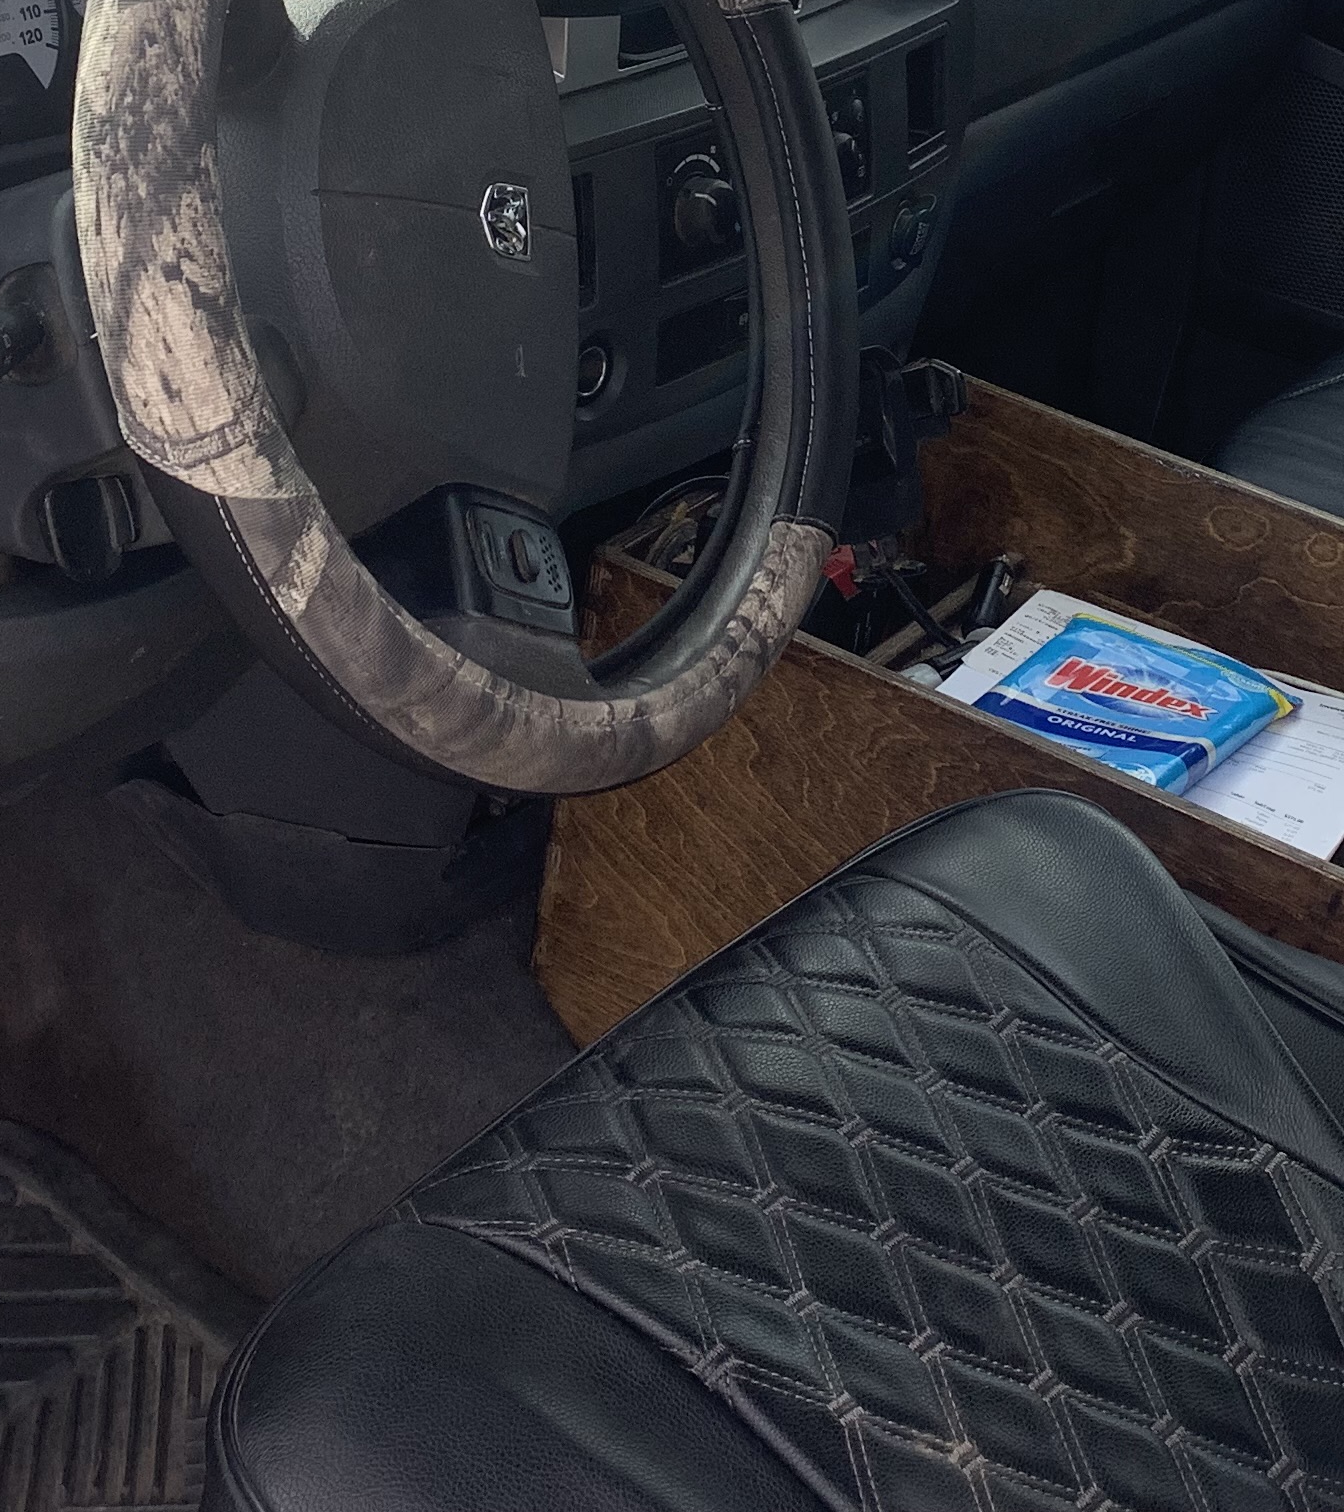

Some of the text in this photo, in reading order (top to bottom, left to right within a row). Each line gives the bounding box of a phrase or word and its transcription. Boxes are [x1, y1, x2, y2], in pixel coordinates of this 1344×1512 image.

[19, 4, 42, 21] 110
[19, 27, 43, 46] 120
[1044, 657, 1216, 721] Windex
[1046, 714, 1138, 744] ORIGINAL
